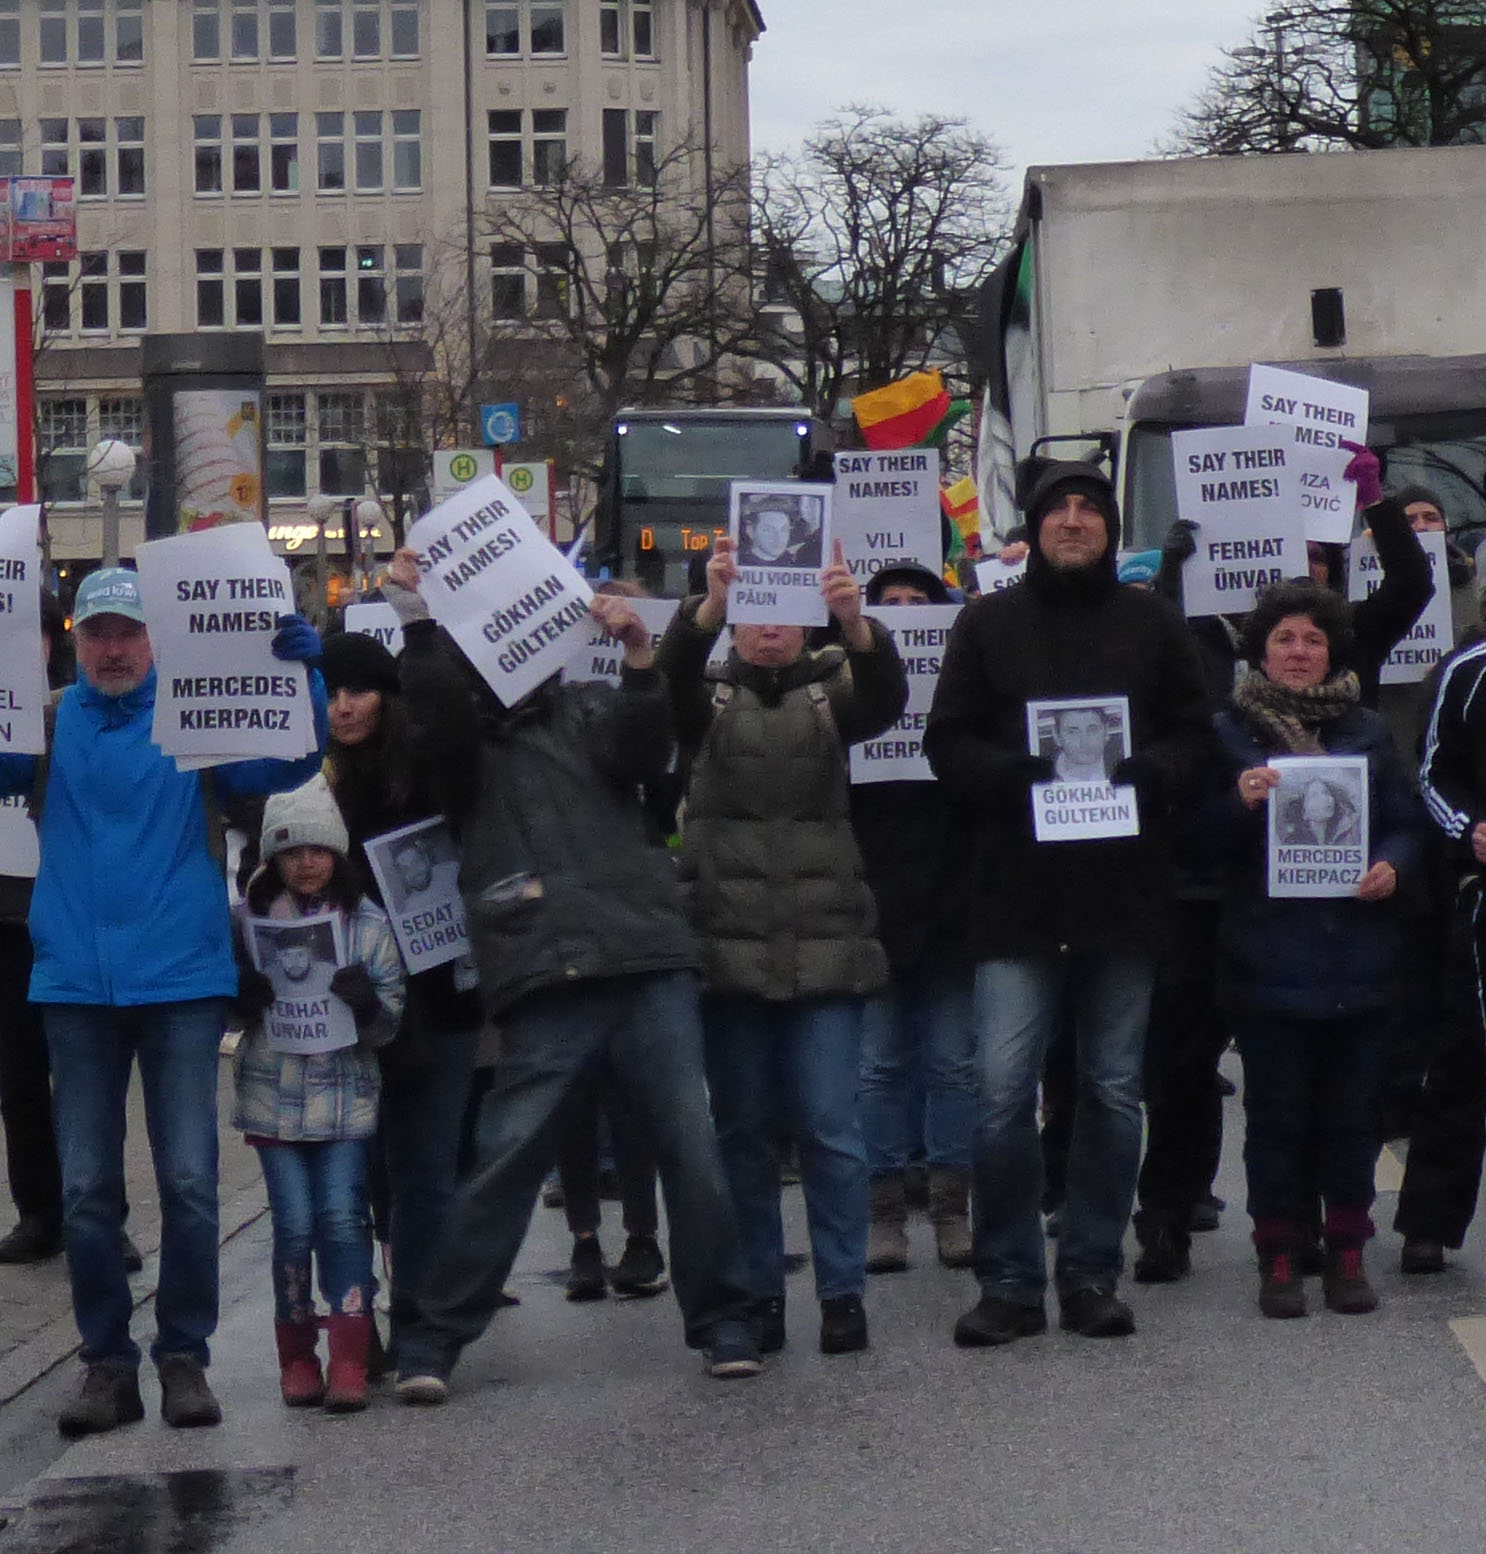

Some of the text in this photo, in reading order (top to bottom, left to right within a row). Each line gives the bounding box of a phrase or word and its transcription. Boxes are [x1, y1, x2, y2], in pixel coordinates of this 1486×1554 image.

[1261, 394, 1356, 428] SAY THEIR
[1295, 426, 1343, 450] MES!
[839, 455, 928, 473] SAY THEIR
[1188, 448, 1286, 474] SAY THEIR
[849, 481, 918, 499] NAMES!
[1201, 478, 1280, 502] NAMES!
[414, 499, 511, 574] SAY THEIR
[865, 532, 905, 548] VILI
[442, 528, 522, 592] NAMES!
[1208, 538, 1285, 561] FERHAT
[176, 578, 286, 602] SAY THEIR
[767, 571, 819, 587] VIOREL
[1214, 566, 1283, 591] ÜNVAR
[482, 575, 566, 644] GÖKHAN
[189, 611, 282, 634] NAMES!
[497, 597, 591, 674] GÜLTEKIN
[1387, 648, 1442, 666] LTEKIN
[172, 676, 298, 699] MERCEDES
[180, 708, 291, 731] KIERPACZ
[1043, 785, 1117, 805] GÖKHAN
[1044, 805, 1130, 825] GÜLTEKIN
[1278, 848, 1363, 864] MERCEDES
[1278, 869, 1361, 885] KIERPACZ
[402, 902, 454, 937] SEDAT
